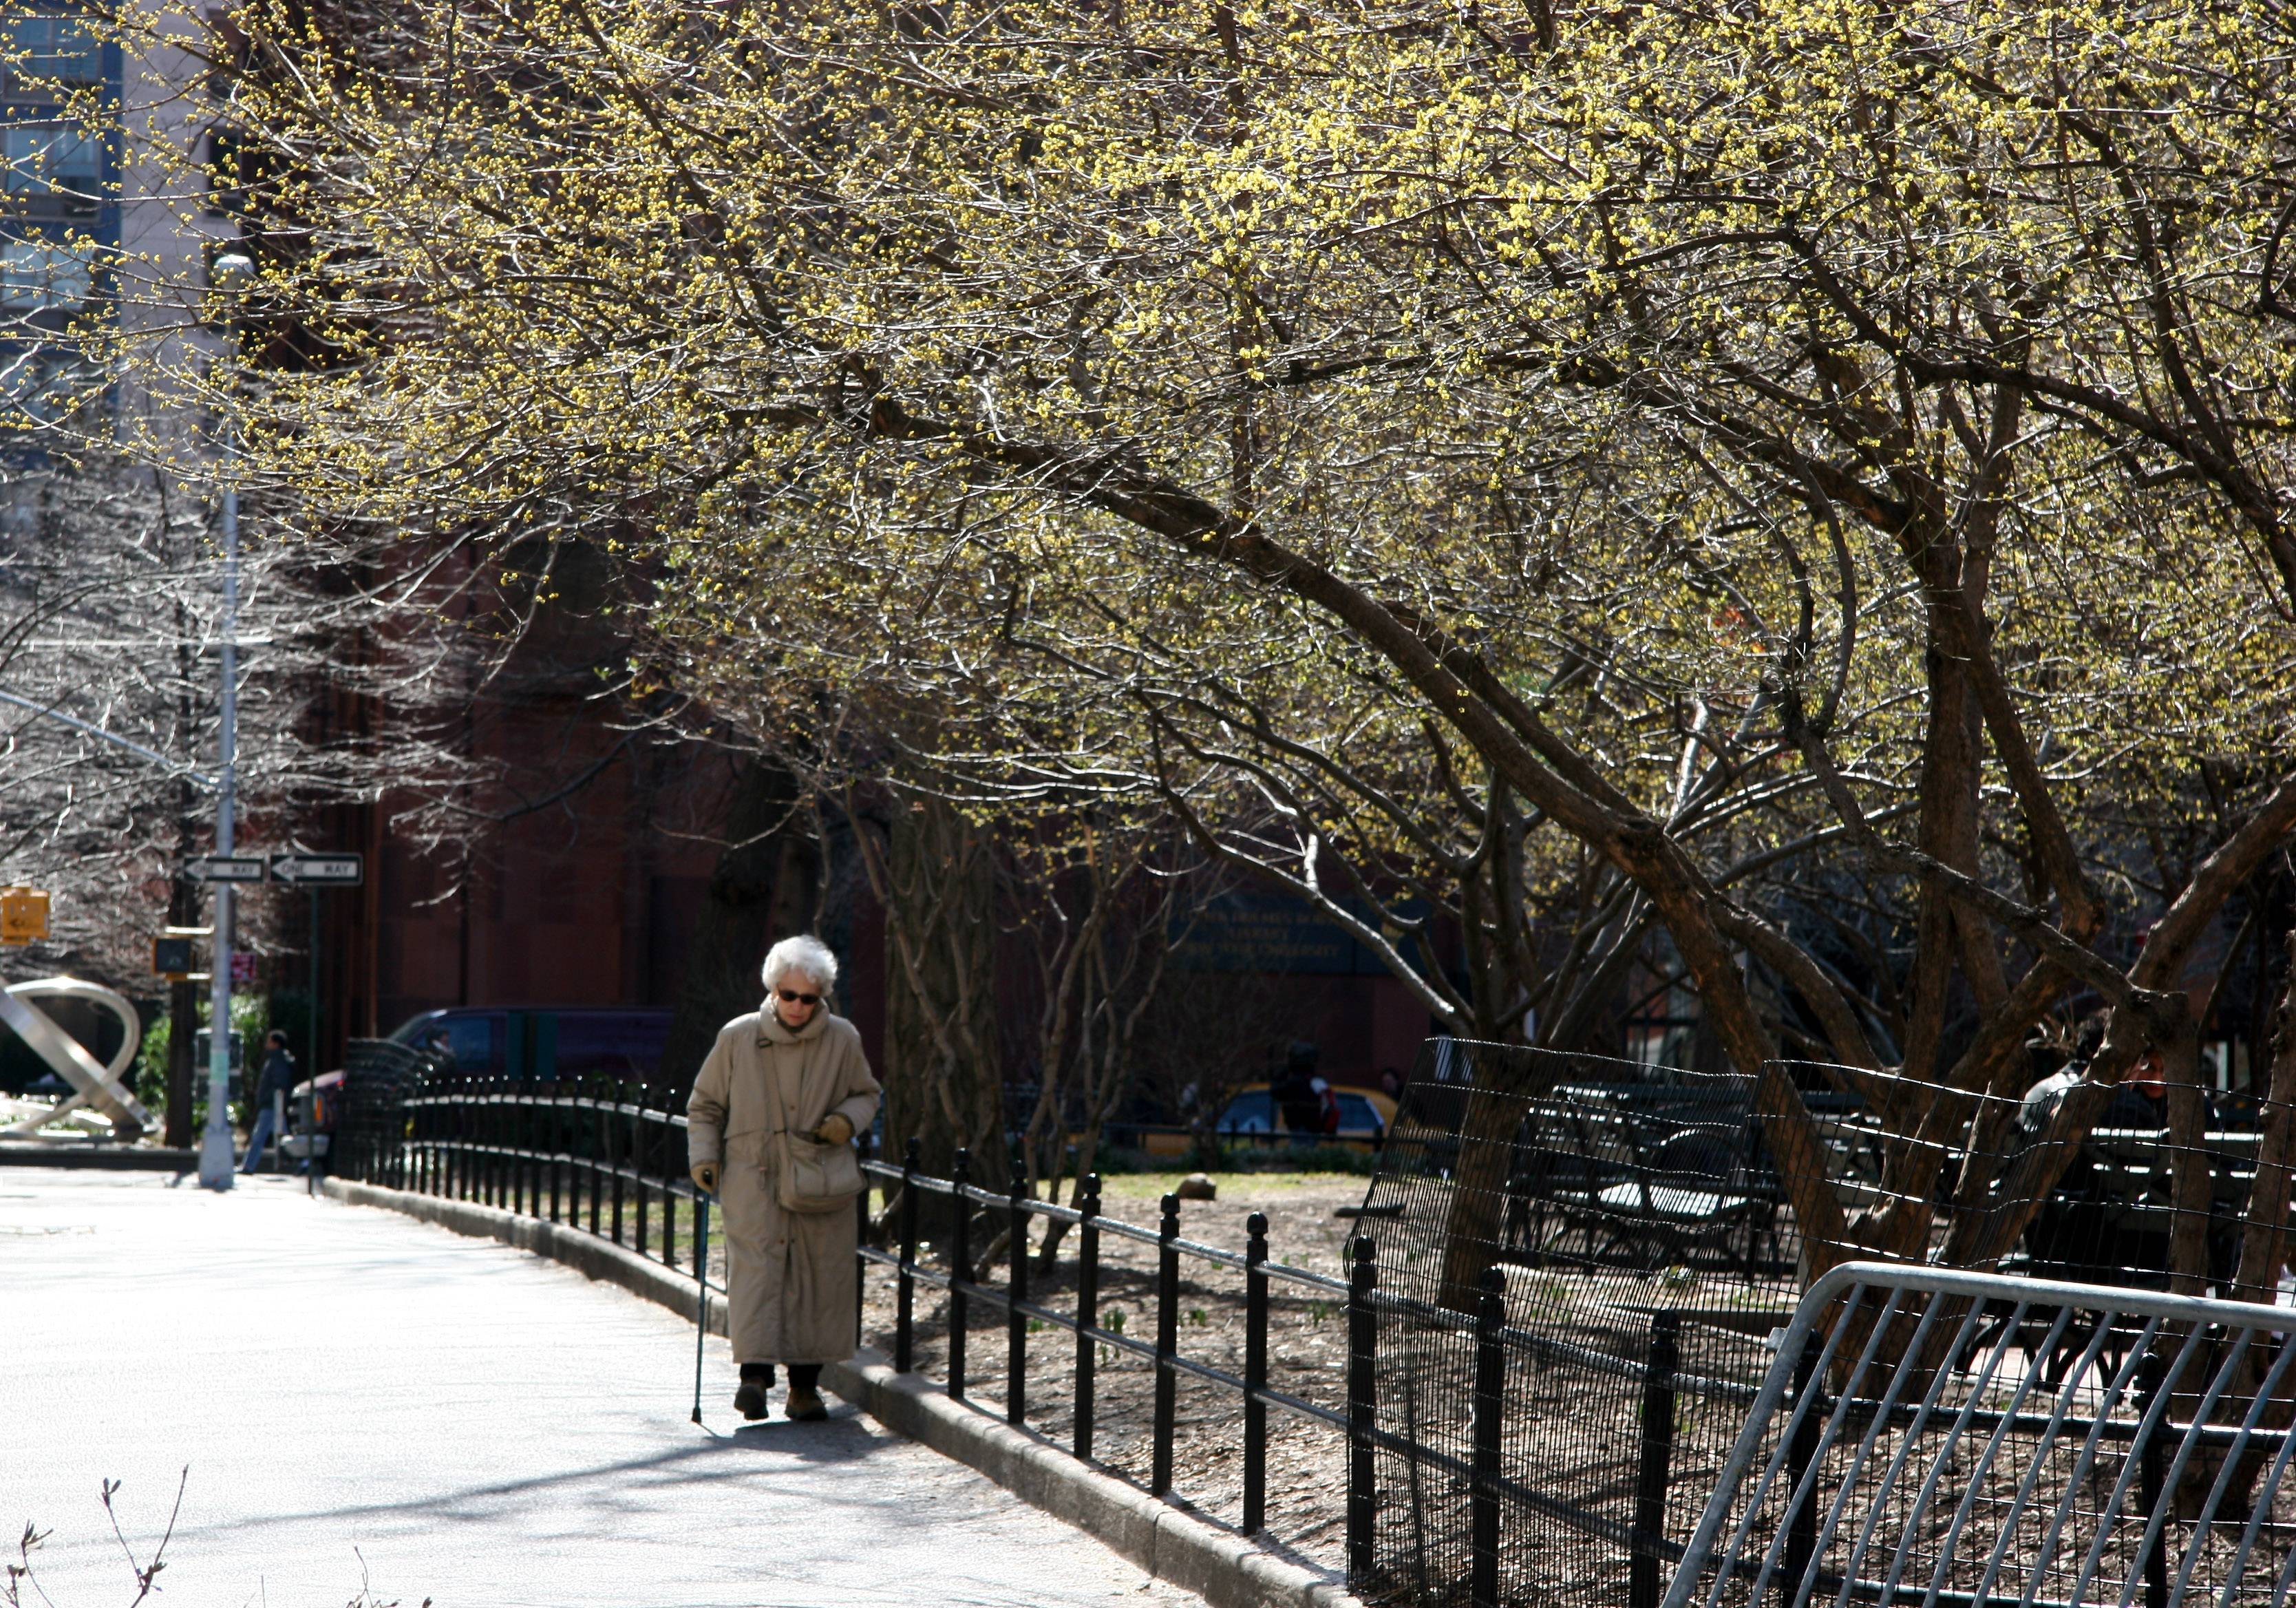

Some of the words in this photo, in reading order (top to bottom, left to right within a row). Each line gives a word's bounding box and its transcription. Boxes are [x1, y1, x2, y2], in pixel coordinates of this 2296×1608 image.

[195, 864, 213, 874] ONE
[233, 865, 254, 874] WAY
[281, 863, 304, 874] ONE
[325, 863, 348, 874] WAY
